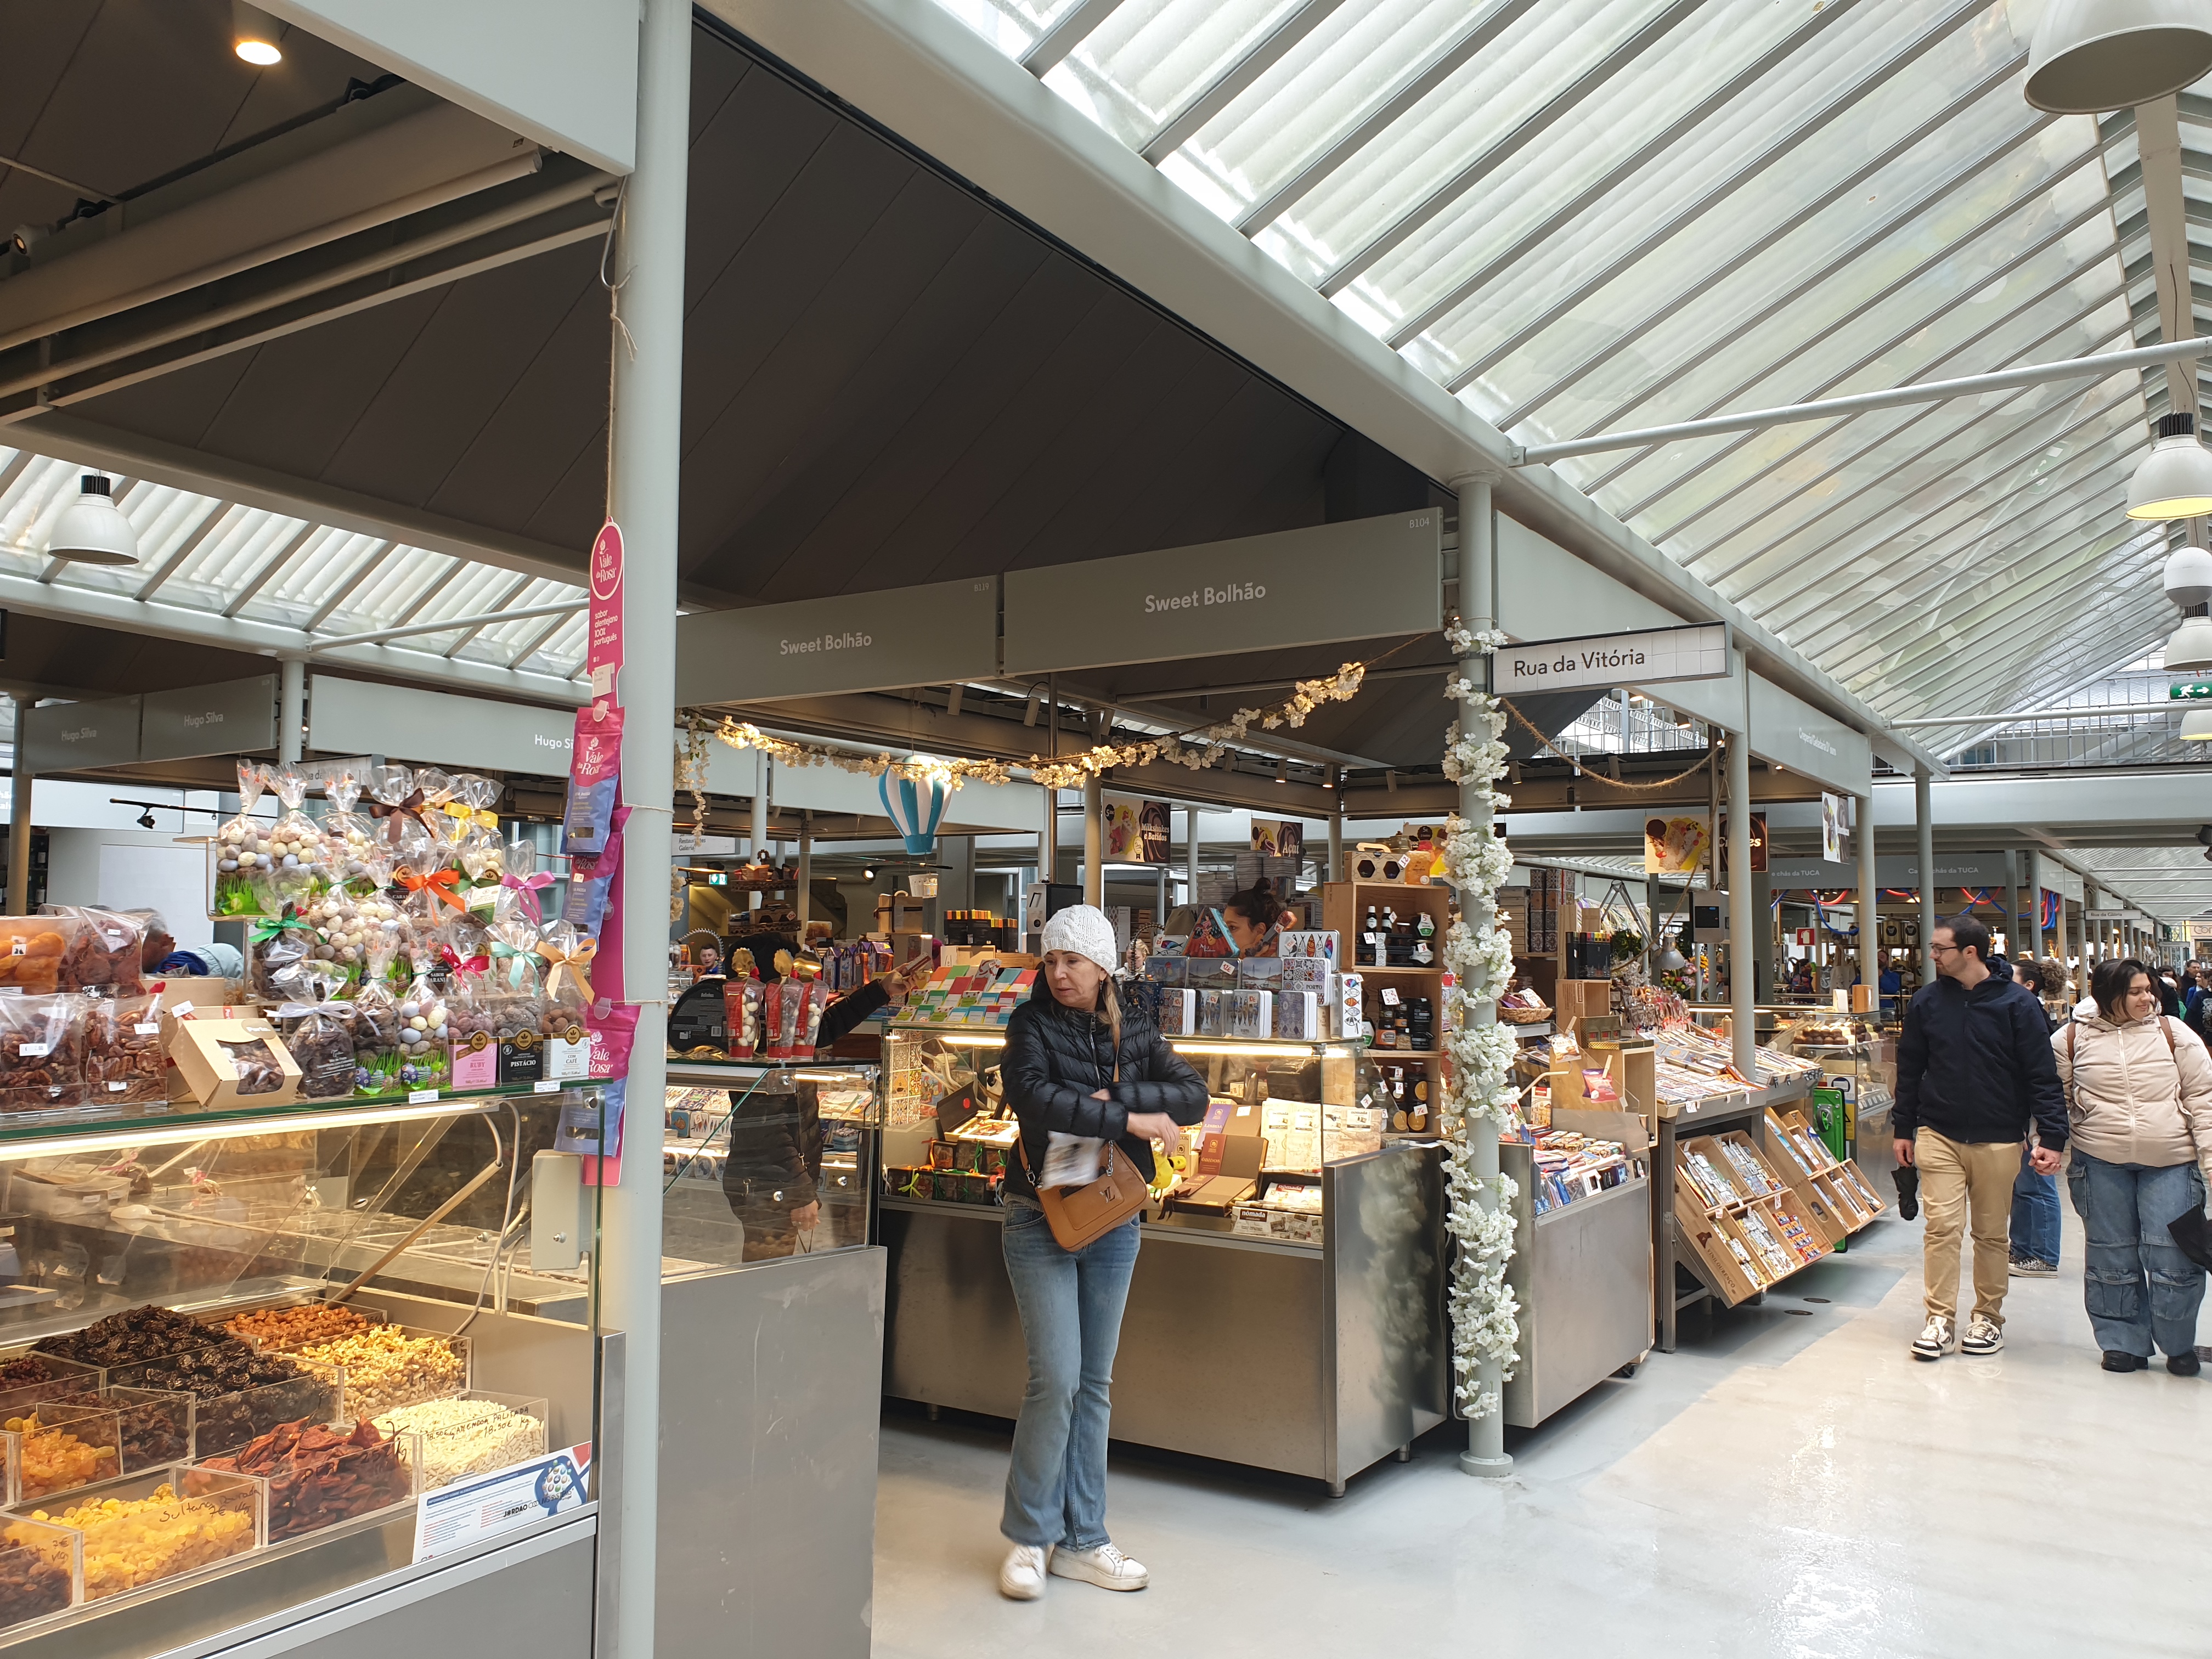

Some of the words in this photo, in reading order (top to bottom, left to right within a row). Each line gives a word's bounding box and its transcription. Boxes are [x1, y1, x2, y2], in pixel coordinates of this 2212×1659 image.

[1409, 517, 1430, 528] B104
[599, 554, 612, 569] Vale
[600, 567, 616, 583] Rosa
[1145, 591, 1199, 613] Sweet
[1204, 582, 1266, 606] Bolhão
[595, 609, 608, 619] sabor
[595, 615, 618, 628] alentejano
[594, 628, 606, 638] 100%
[594, 634, 617, 648] português
[780, 637, 822, 656] Sweet
[825, 632, 872, 651] Bolhão
[1514, 661, 1548, 678] Rua
[1553, 655, 1576, 673] da
[1581, 648, 1645, 669] Vitória
[183, 715, 204, 727] Hugo
[205, 711, 224, 724] Silva
[61, 730, 80, 742] Hugo
[81, 727, 97, 739] Silva
[535, 734, 562, 749] Hugo
[586, 751, 604, 764] Vale
[1141, 823, 1170, 833] Milkshakes
[1148, 832, 1167, 841] Batidos
[1283, 841, 1300, 857] Açaí
[511, 1059, 537, 1068] PISTÁCIO
[1707, 1248, 1735, 1288] VINILOURENÇO
